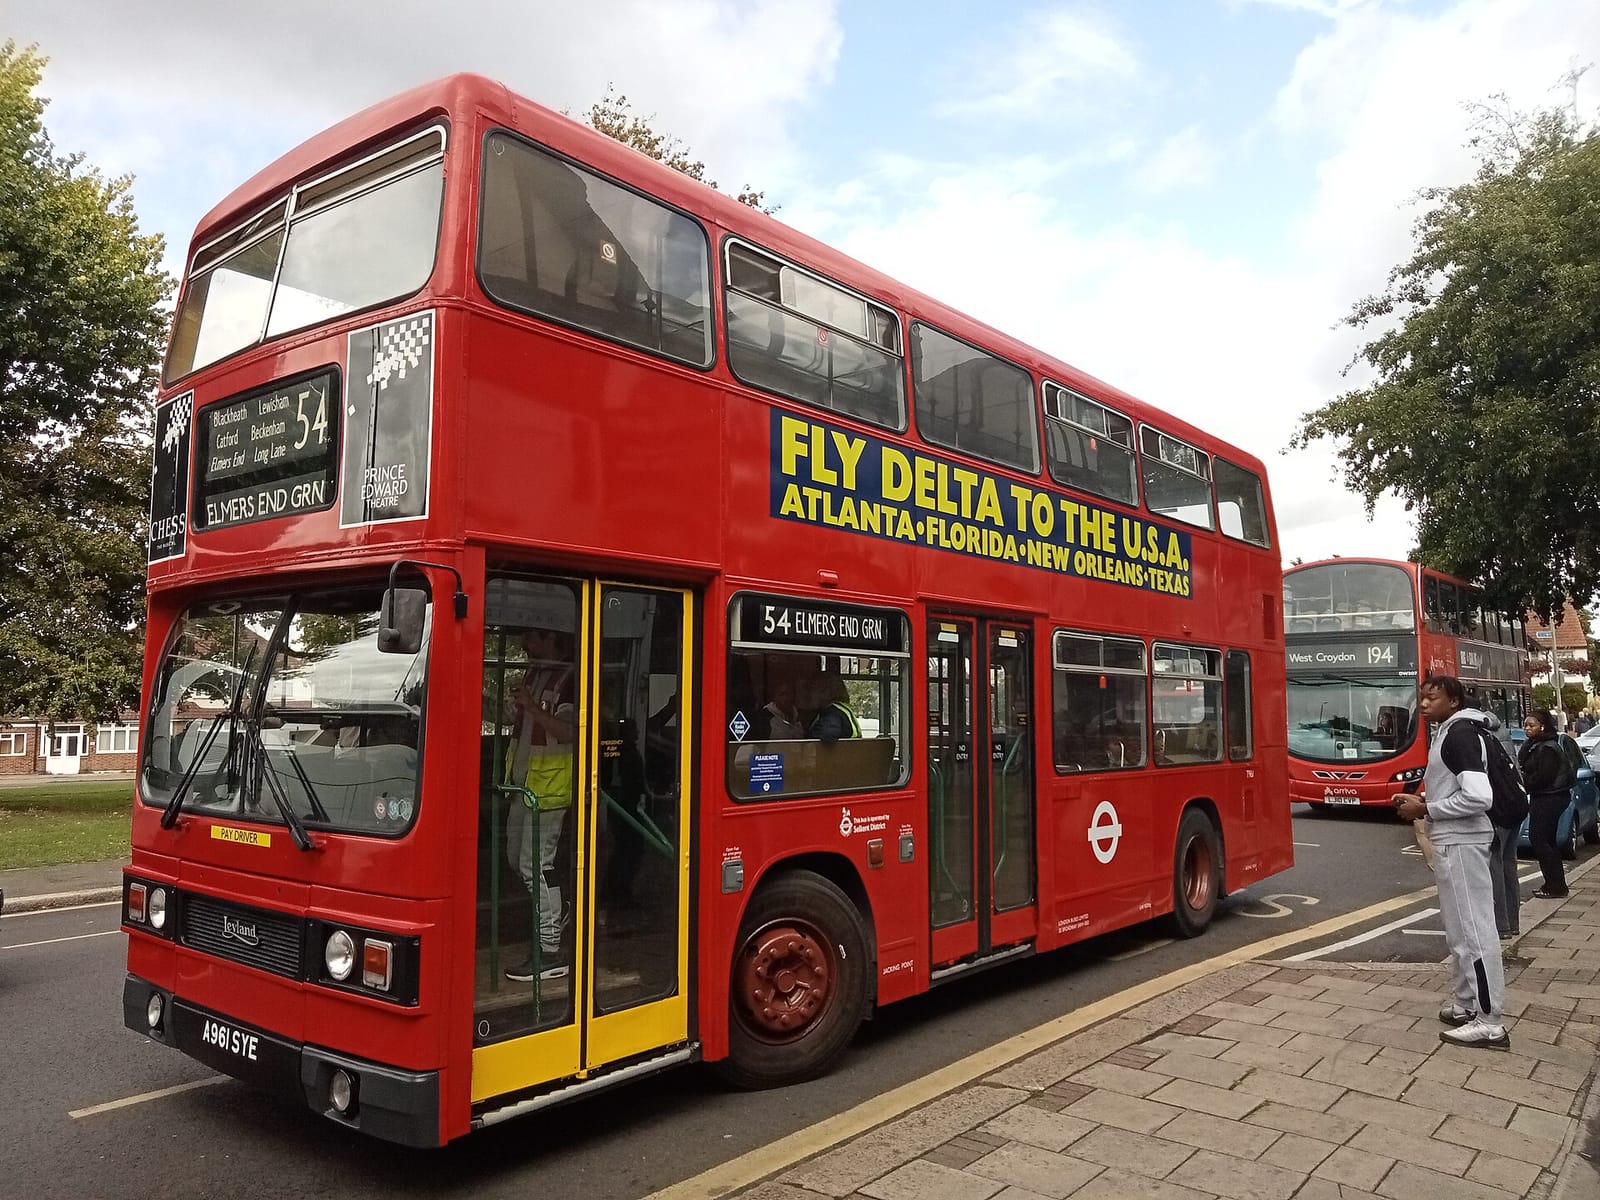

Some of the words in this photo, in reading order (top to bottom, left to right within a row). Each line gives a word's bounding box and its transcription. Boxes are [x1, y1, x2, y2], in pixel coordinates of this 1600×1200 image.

[258, 395, 289, 415] Lewisham
[213, 407, 247, 427] Blackheath
[293, 387, 329, 450] 54
[216, 430, 239, 449] Catford
[251, 420, 286, 441] Beckenham
[210, 454, 231, 472] Elmers
[232, 450, 246, 468] End
[254, 446, 269, 465] Long
[270, 443, 286, 459] Lane
[364, 464, 406, 482] PRINCE
[361, 479, 408, 500] EDWARD
[781, 415, 867, 491] FLY
[881, 446, 1004, 528] DELTA
[1010, 484, 1055, 537] TO
[1060, 499, 1117, 554] THE
[1121, 517, 1190, 571] U.S.A.
[207, 495, 254, 526] ELMERS
[258, 489, 287, 515] END
[290, 480, 326, 508] GRN
[366, 495, 399, 509] THEATRE
[151, 513, 186, 542] CHESS
[780, 483, 916, 541] ATLANTA
[925, 516, 1019, 562] FLORIDA
[1026, 539, 1070, 572] NEW
[1073, 554, 1144, 587] ORLEANS
[1147, 566, 1191, 597] TEXAS
[763, 606, 792, 635] 54
[795, 611, 836, 637] ELMERS
[839, 616, 859, 638] END
[862, 618, 883, 640] GRN
[1289, 653, 1313, 663] West
[1316, 652, 1356, 664] Croydon
[1367, 646, 1394, 664] 194
[220, 827, 236, 841] PAY
[235, 829, 258, 844] DRIVER
[222, 915, 259, 945] Leyland
[202, 1019, 230, 1051] A961
[232, 1029, 259, 1061] SYE
